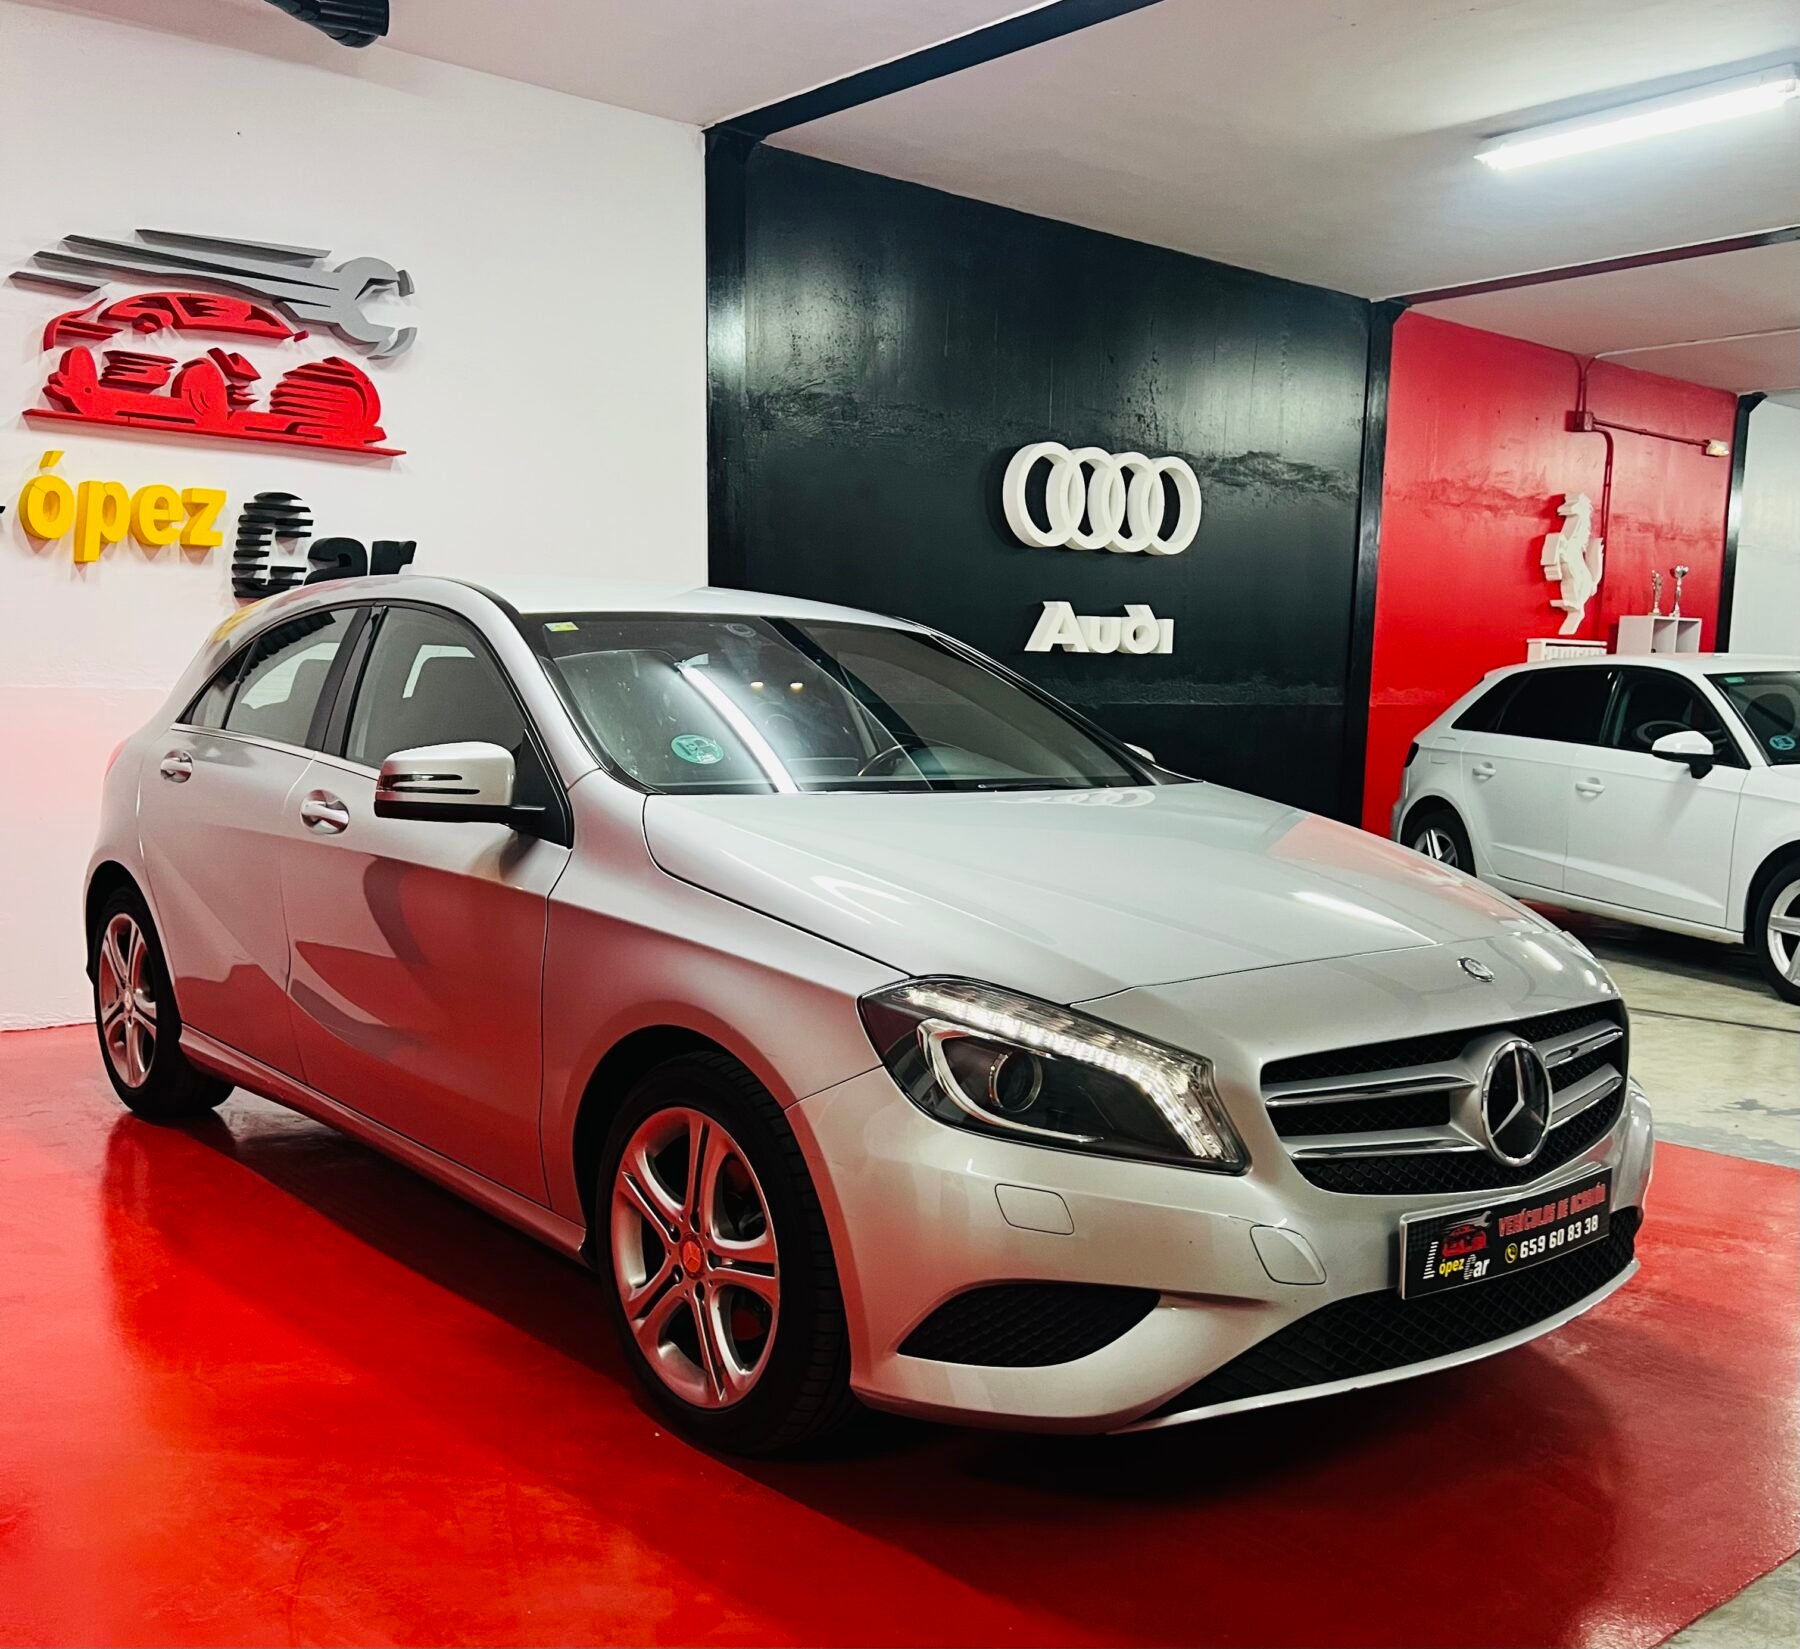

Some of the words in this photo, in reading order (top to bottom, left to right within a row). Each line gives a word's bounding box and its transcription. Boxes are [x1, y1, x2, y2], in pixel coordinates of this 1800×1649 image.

[0, 450, 226, 563] ópez
[232, 492, 417, 598] Car
[1024, 601, 1175, 654] Audi
[1520, 1234, 1546, 1259] 659
[1549, 1228, 1566, 1249] 60
[1567, 1221, 1582, 1242] 83
[1584, 1214, 1599, 1235] 38
